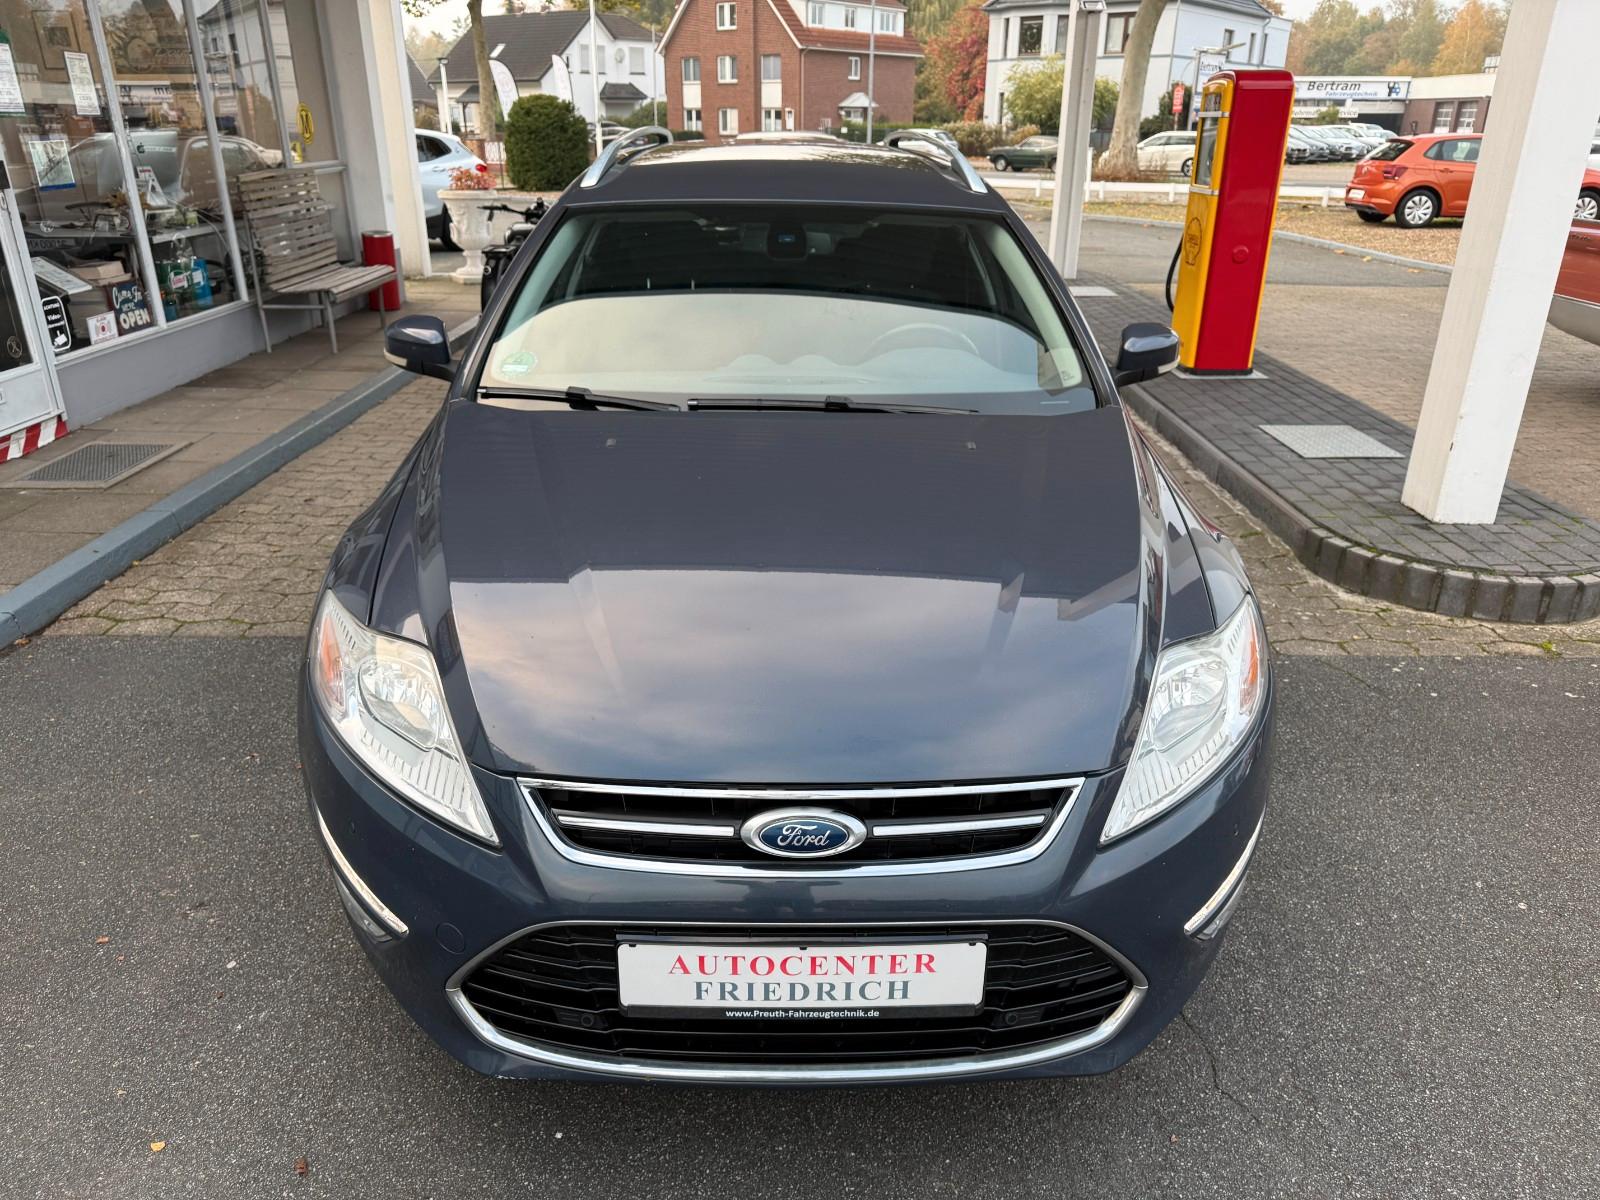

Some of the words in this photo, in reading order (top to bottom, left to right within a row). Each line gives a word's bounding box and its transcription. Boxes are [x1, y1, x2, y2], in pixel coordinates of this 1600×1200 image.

[1307, 81, 1361, 91] Bertram
[43, 302, 60, 311] ACHTUNG
[47, 313, 62, 321] Video-
[120, 308, 151, 329] OPEN
[777, 824, 831, 846] Ford
[668, 953, 937, 977] AUTOCENTER
[693, 980, 911, 1002] FRIEDRICH
[725, 1009, 880, 1020] www.Preuth-Fahrzeugtechnik.de
